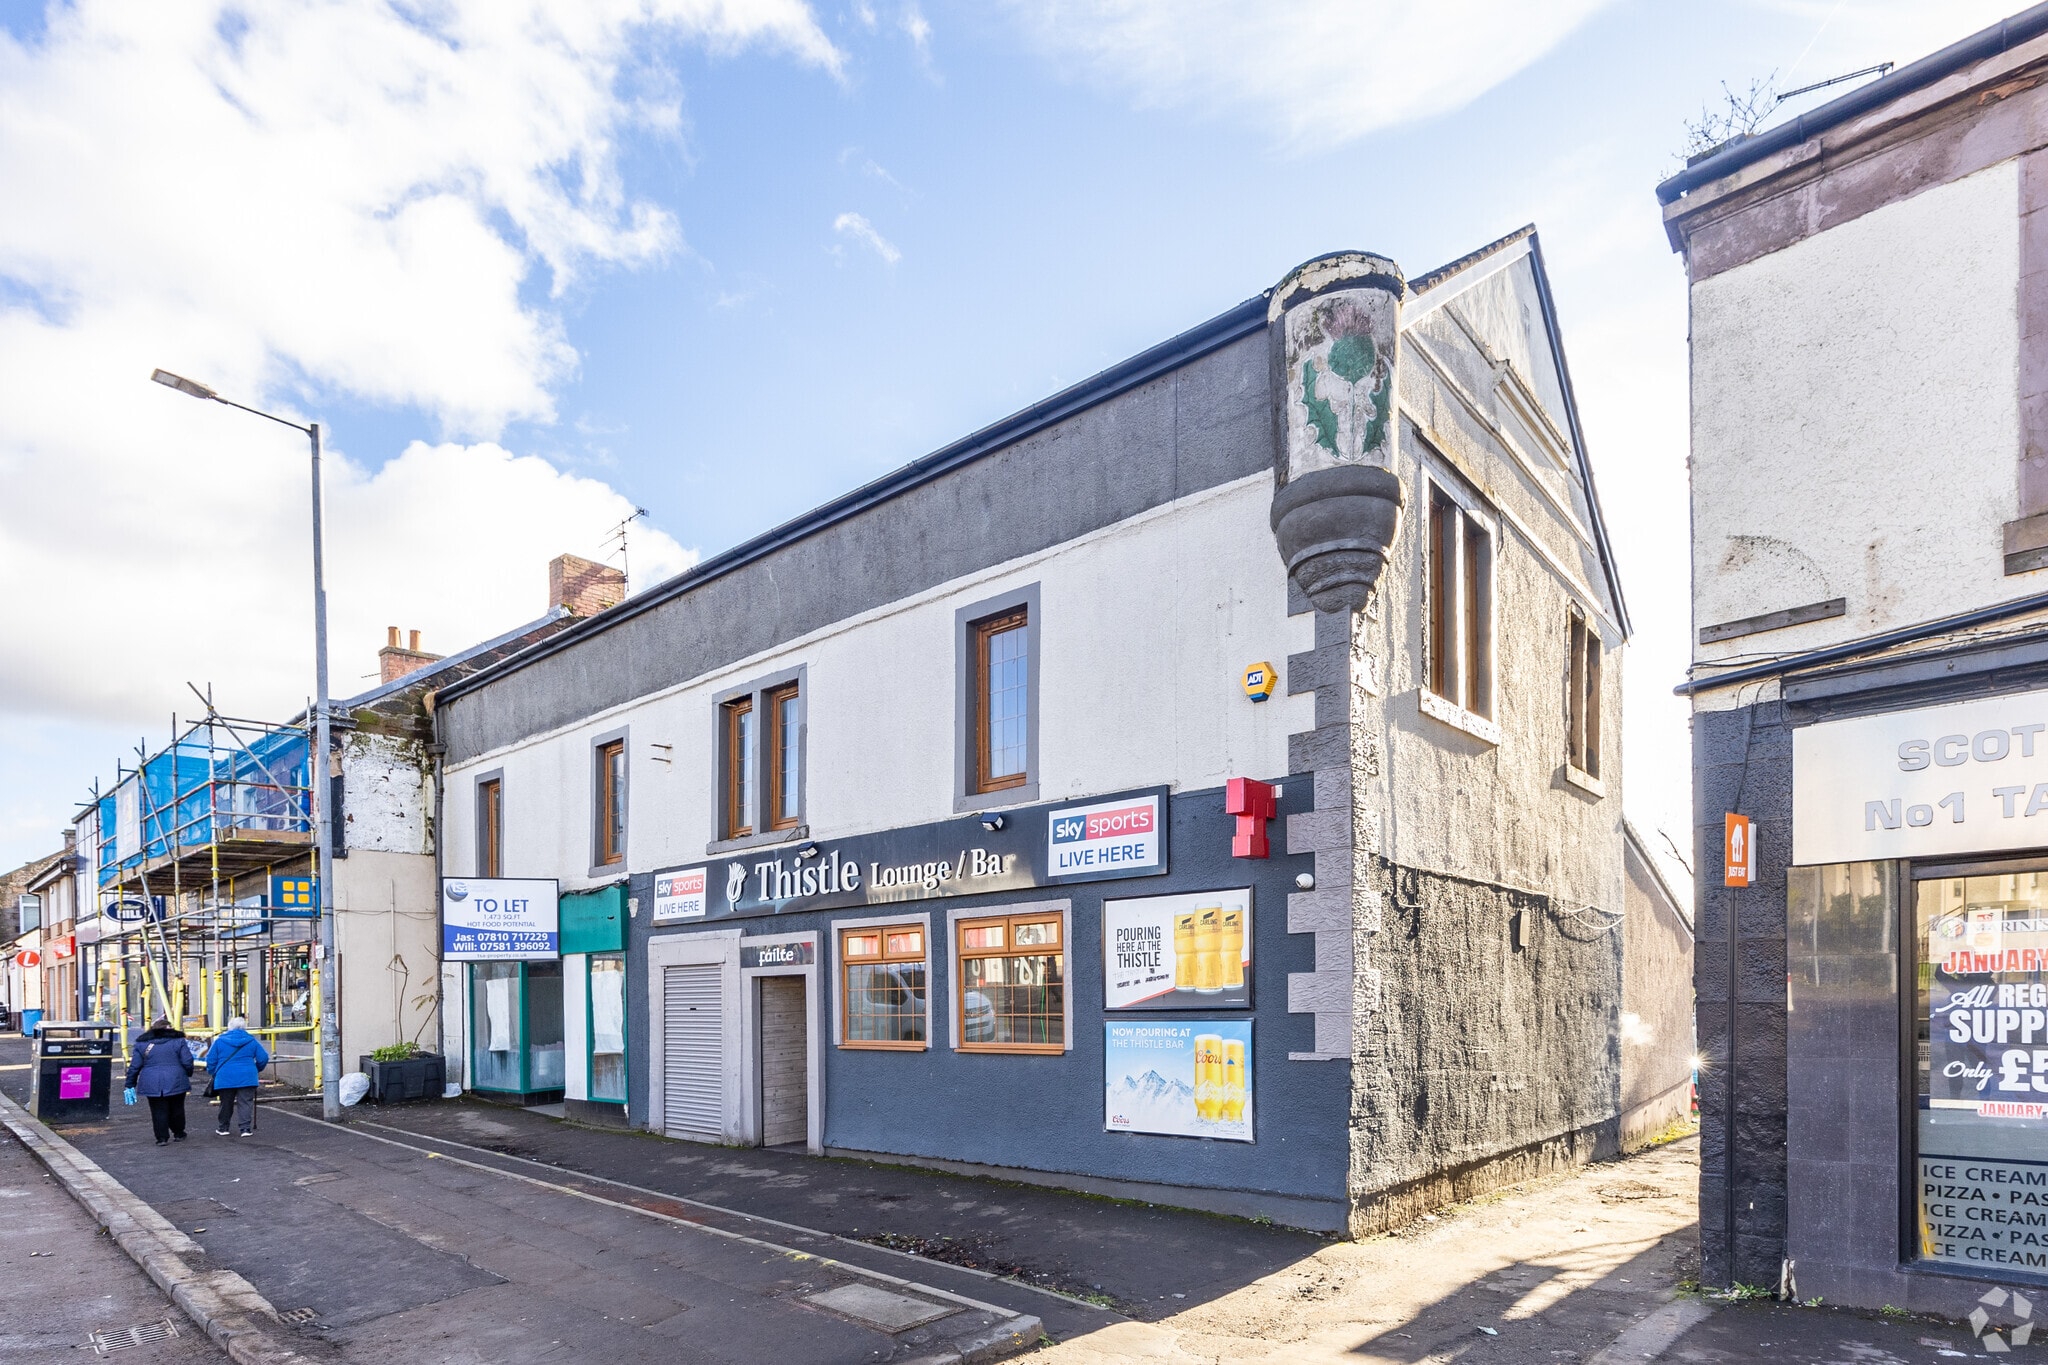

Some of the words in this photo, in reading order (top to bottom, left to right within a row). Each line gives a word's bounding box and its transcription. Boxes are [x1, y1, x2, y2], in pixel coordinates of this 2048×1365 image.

[1247, 672, 1263, 685] ADT
[1897, 723, 2045, 772] SCOT
[1865, 792, 1965, 831] No1
[1992, 782, 2048, 818] TA
[1056, 819, 1084, 840] sky
[1089, 811, 1149, 836] sports
[1059, 849, 1094, 868] LIVE
[1098, 843, 1145, 864] HERE
[755, 850, 860, 901] Thistle
[870, 861, 950, 889] Lounge
[658, 882, 672, 896] sky
[673, 878, 702, 893] sports
[474, 898, 498, 913] TO
[504, 899, 529, 913] LET
[659, 902, 676, 915] LIVE
[677, 900, 700, 913] HERE
[455, 933, 475, 942] Jas:
[477, 933, 509, 941] 07810
[511, 932, 548, 941] 717229
[1116, 926, 1161, 942] POURING
[453, 942, 477, 951] Will:
[480, 942, 511, 951] 07581
[514, 942, 550, 950] 396092
[1116, 942, 1136, 953] HERE
[1137, 941, 1146, 952] AT
[1147, 940, 1161, 951] THE
[1116, 951, 1161, 969] THISTLE
[1942, 948, 2048, 973] JANUARY
[1935, 984, 1996, 1013] All
[1998, 983, 2048, 1008] REG
[1112, 1027, 1134, 1037] NOW
[1135, 1027, 1178, 1037] POURING
[1179, 1028, 1191, 1038] AT
[1949, 1009, 2048, 1044] SUPP
[1112, 1039, 1129, 1048] THE
[1130, 1039, 1164, 1049] THISTLE
[1166, 1040, 1185, 1049] BAR
[1195, 1049, 1222, 1065] Coors
[1942, 1060, 1994, 1092] Only
[1998, 1049, 2048, 1093] £5
[1979, 1103, 2043, 1118] JANUARY
[1923, 1164, 1956, 1180] ICE
[1965, 1167, 2047, 1187] CREAM
[1924, 1183, 1987, 1202] PIZZA
[1923, 1203, 1956, 1219] ICE
[1965, 1207, 2047, 1227] CREAM
[1925, 1222, 1987, 1241] PIZZA
[1965, 1246, 2047, 1268] CREAM
